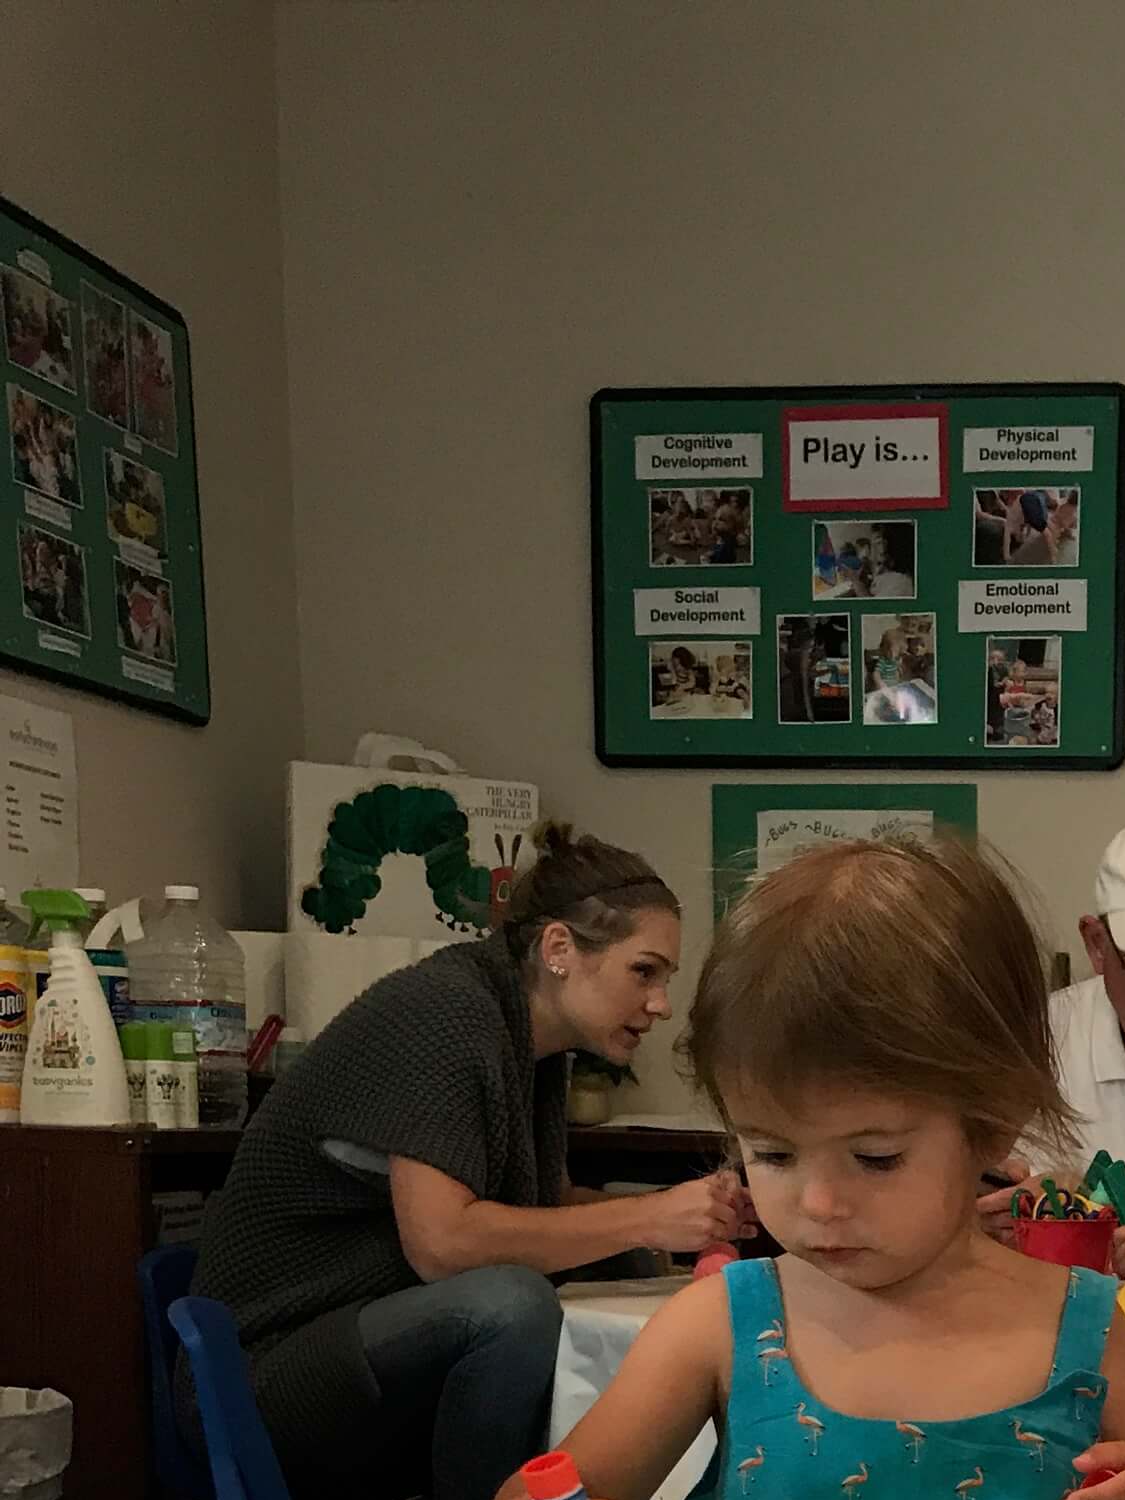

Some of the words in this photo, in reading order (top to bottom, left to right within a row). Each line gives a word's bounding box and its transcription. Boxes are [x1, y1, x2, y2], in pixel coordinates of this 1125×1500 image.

[663, 435, 733, 452] Cognitive
[996, 428, 1060, 445] Physical
[802, 437, 866, 469] Play
[875, 435, 929, 462] is...
[979, 447, 1078, 463] Development
[651, 454, 749, 470] Development
[674, 590, 720, 603] Social
[986, 582, 1059, 597] Emotional
[649, 608, 747, 624] Development
[974, 600, 1071, 617] Development
